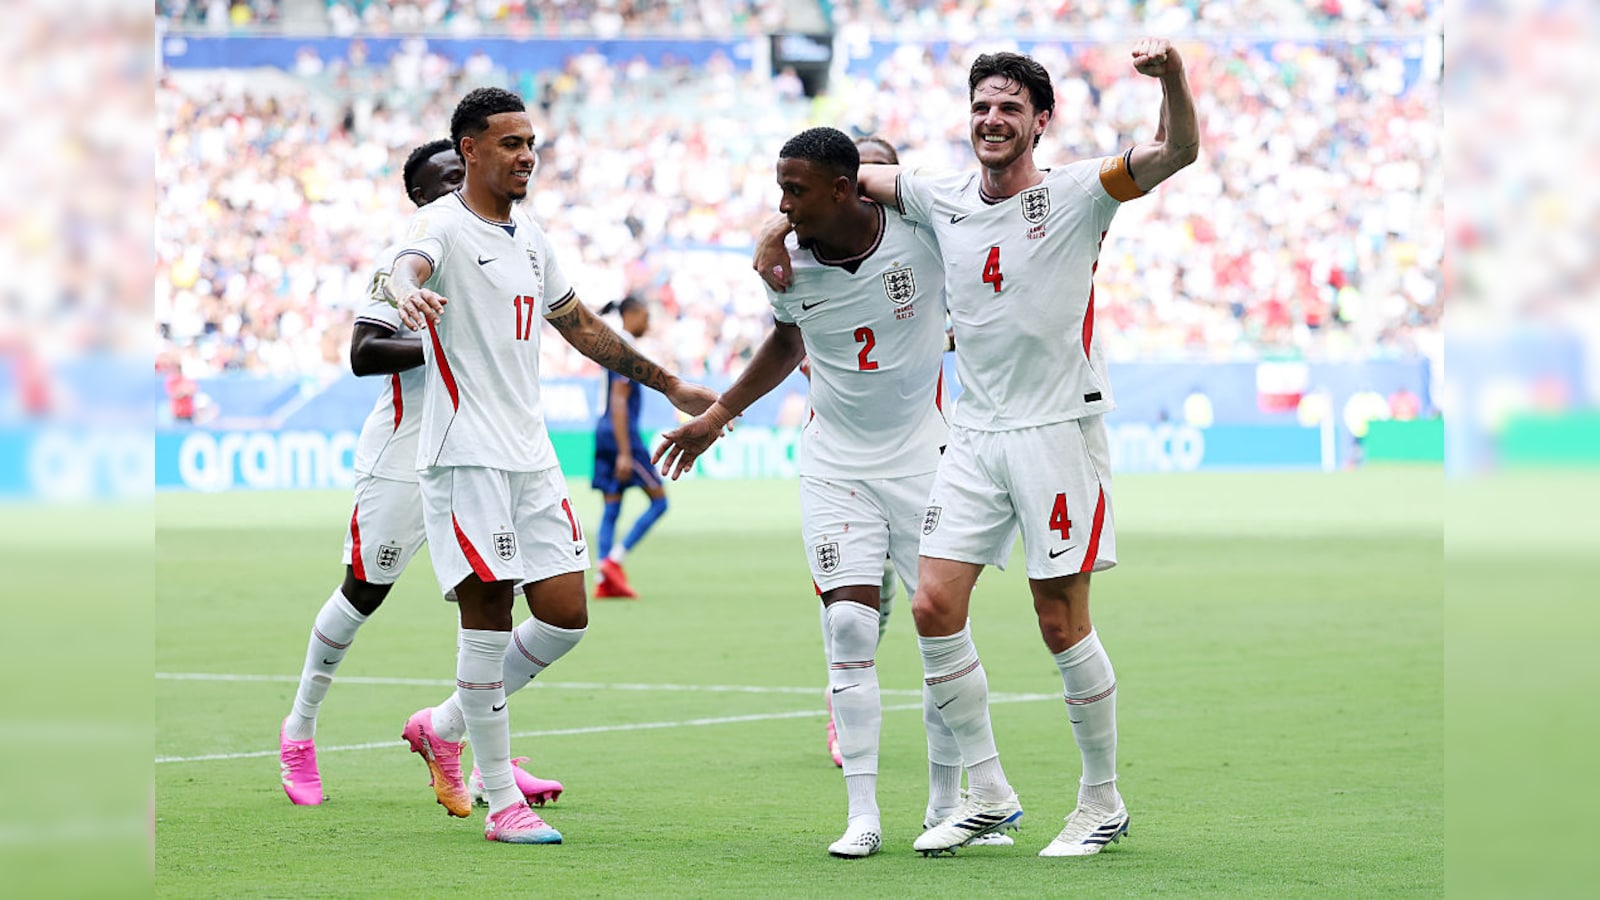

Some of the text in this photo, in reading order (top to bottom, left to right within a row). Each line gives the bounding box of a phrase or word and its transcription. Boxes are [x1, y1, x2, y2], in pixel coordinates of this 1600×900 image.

[982, 246, 1004, 293] 4
[513, 295, 534, 341] 17
[854, 327, 878, 370] 2
[179, 430, 357, 491] aramc
[1049, 493, 1072, 540] 4
